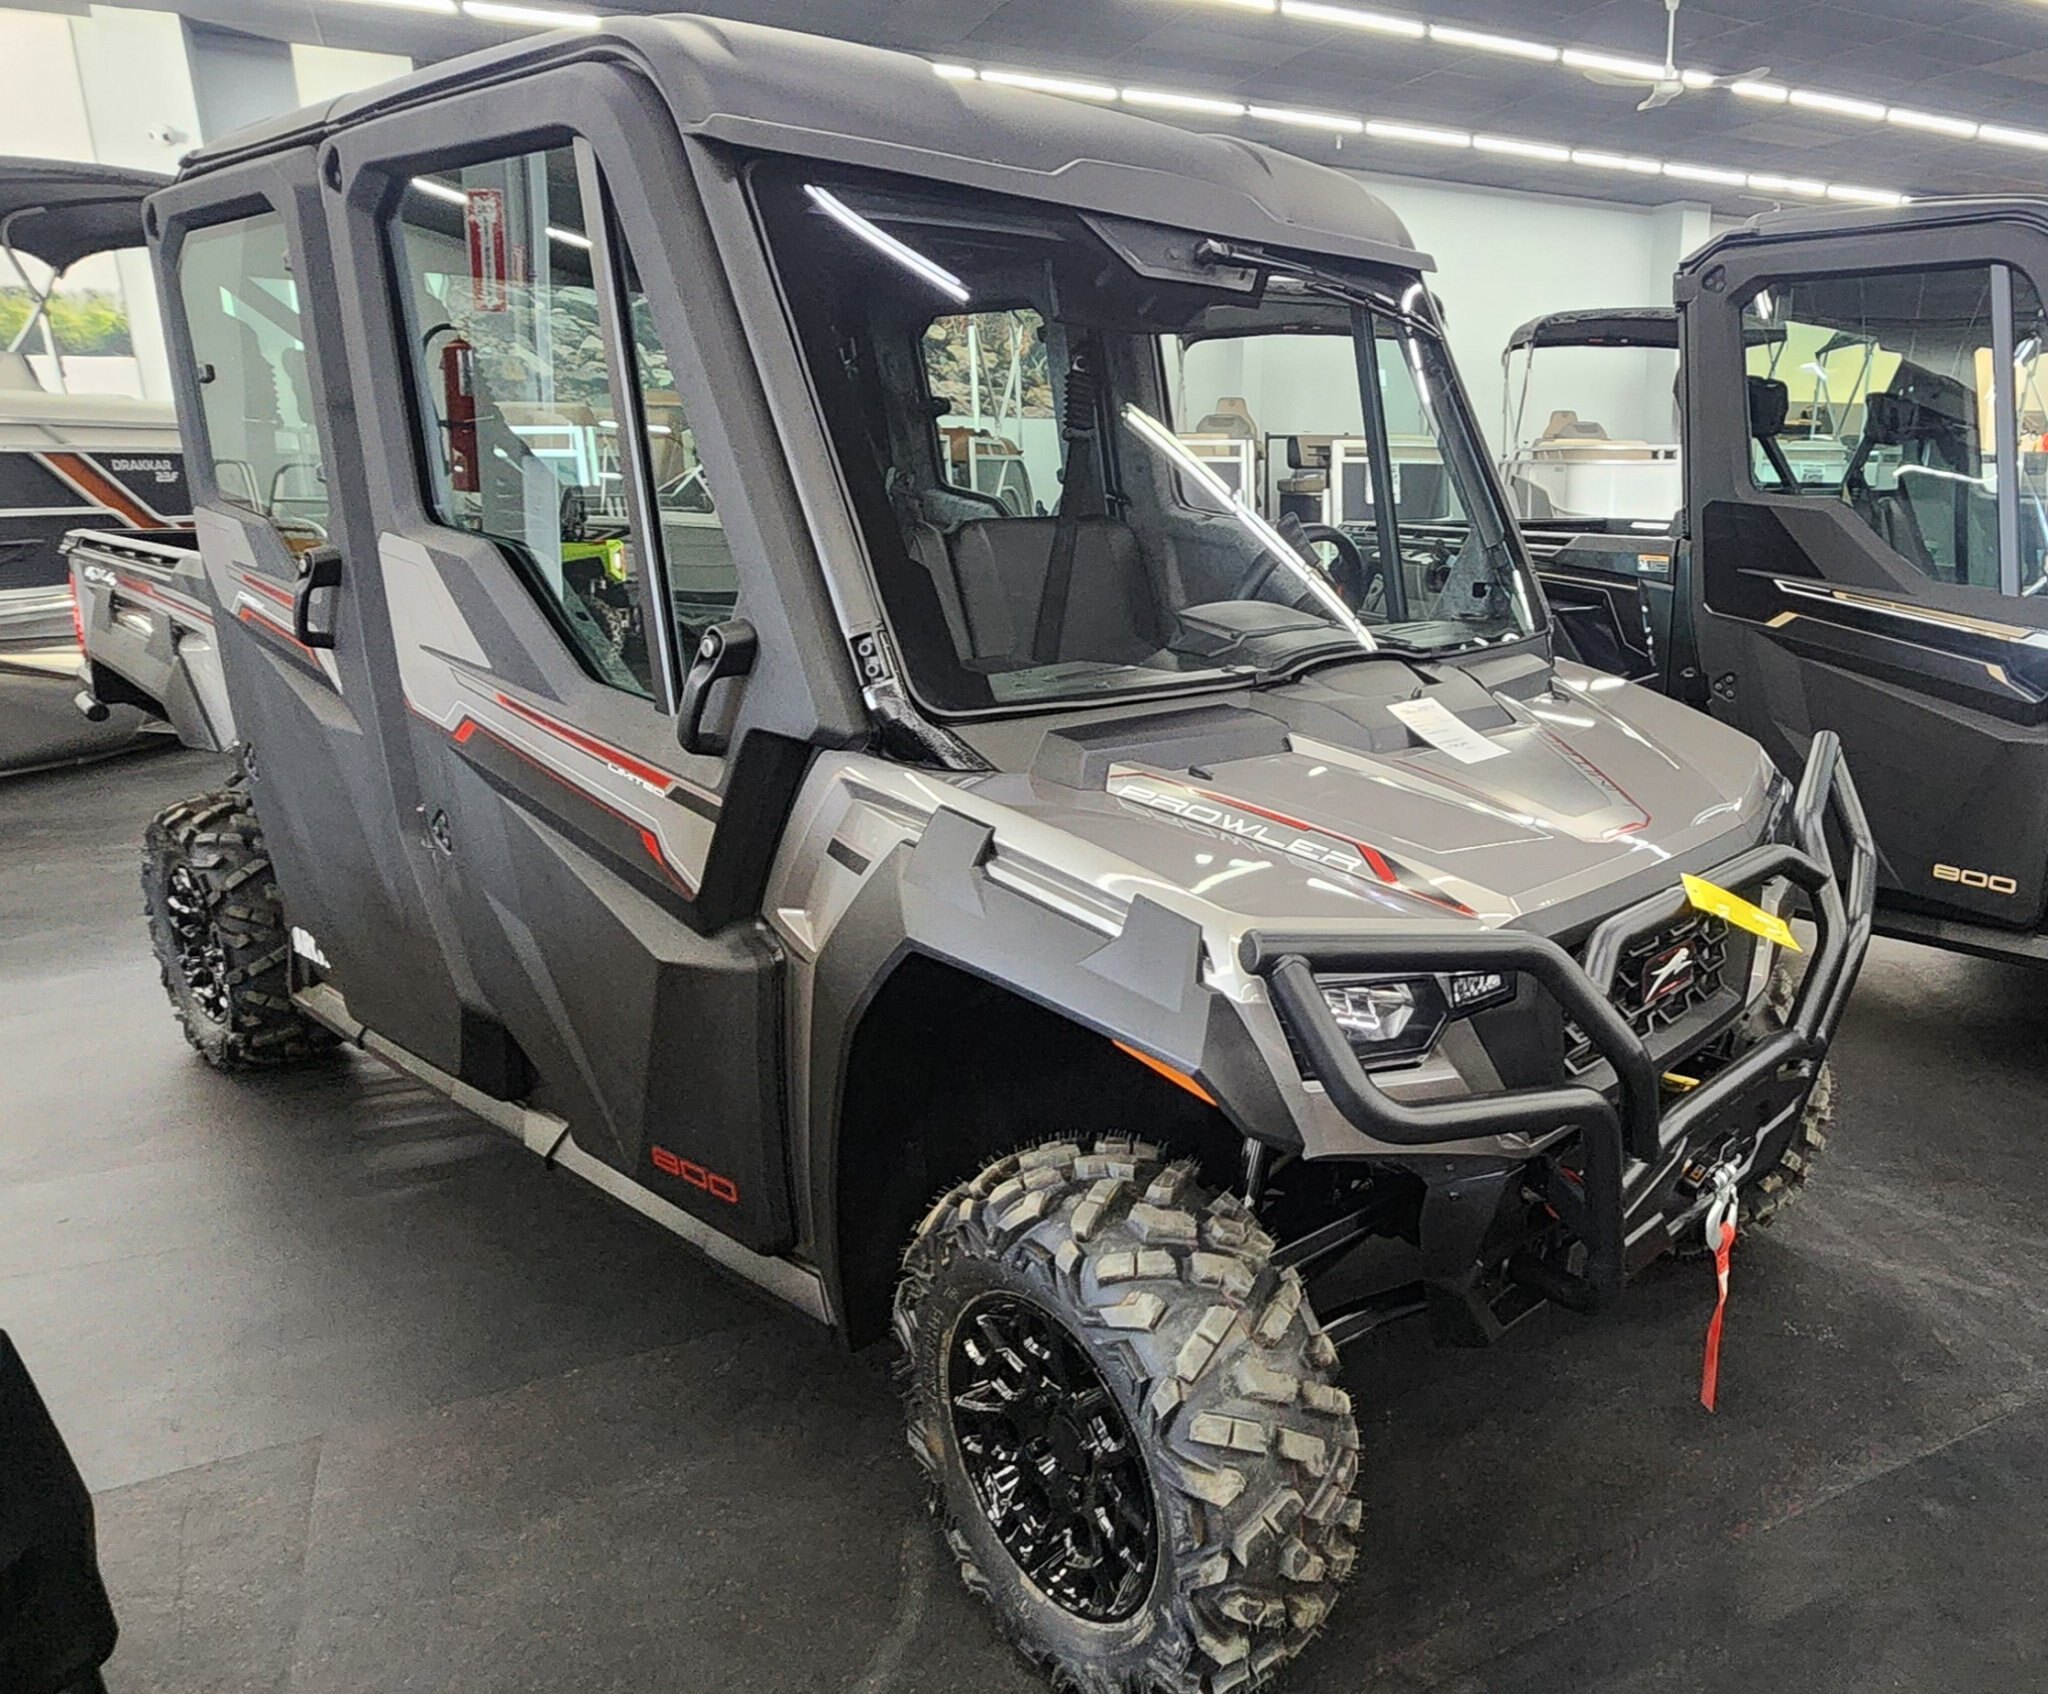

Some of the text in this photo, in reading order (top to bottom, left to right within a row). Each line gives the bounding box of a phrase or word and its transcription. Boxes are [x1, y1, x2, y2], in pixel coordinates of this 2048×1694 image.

[111, 459, 172, 471] DRAKKAR
[1116, 784, 1363, 873] PROWLER
[1933, 863, 2017, 894] 800
[650, 1145, 739, 1203] 800
